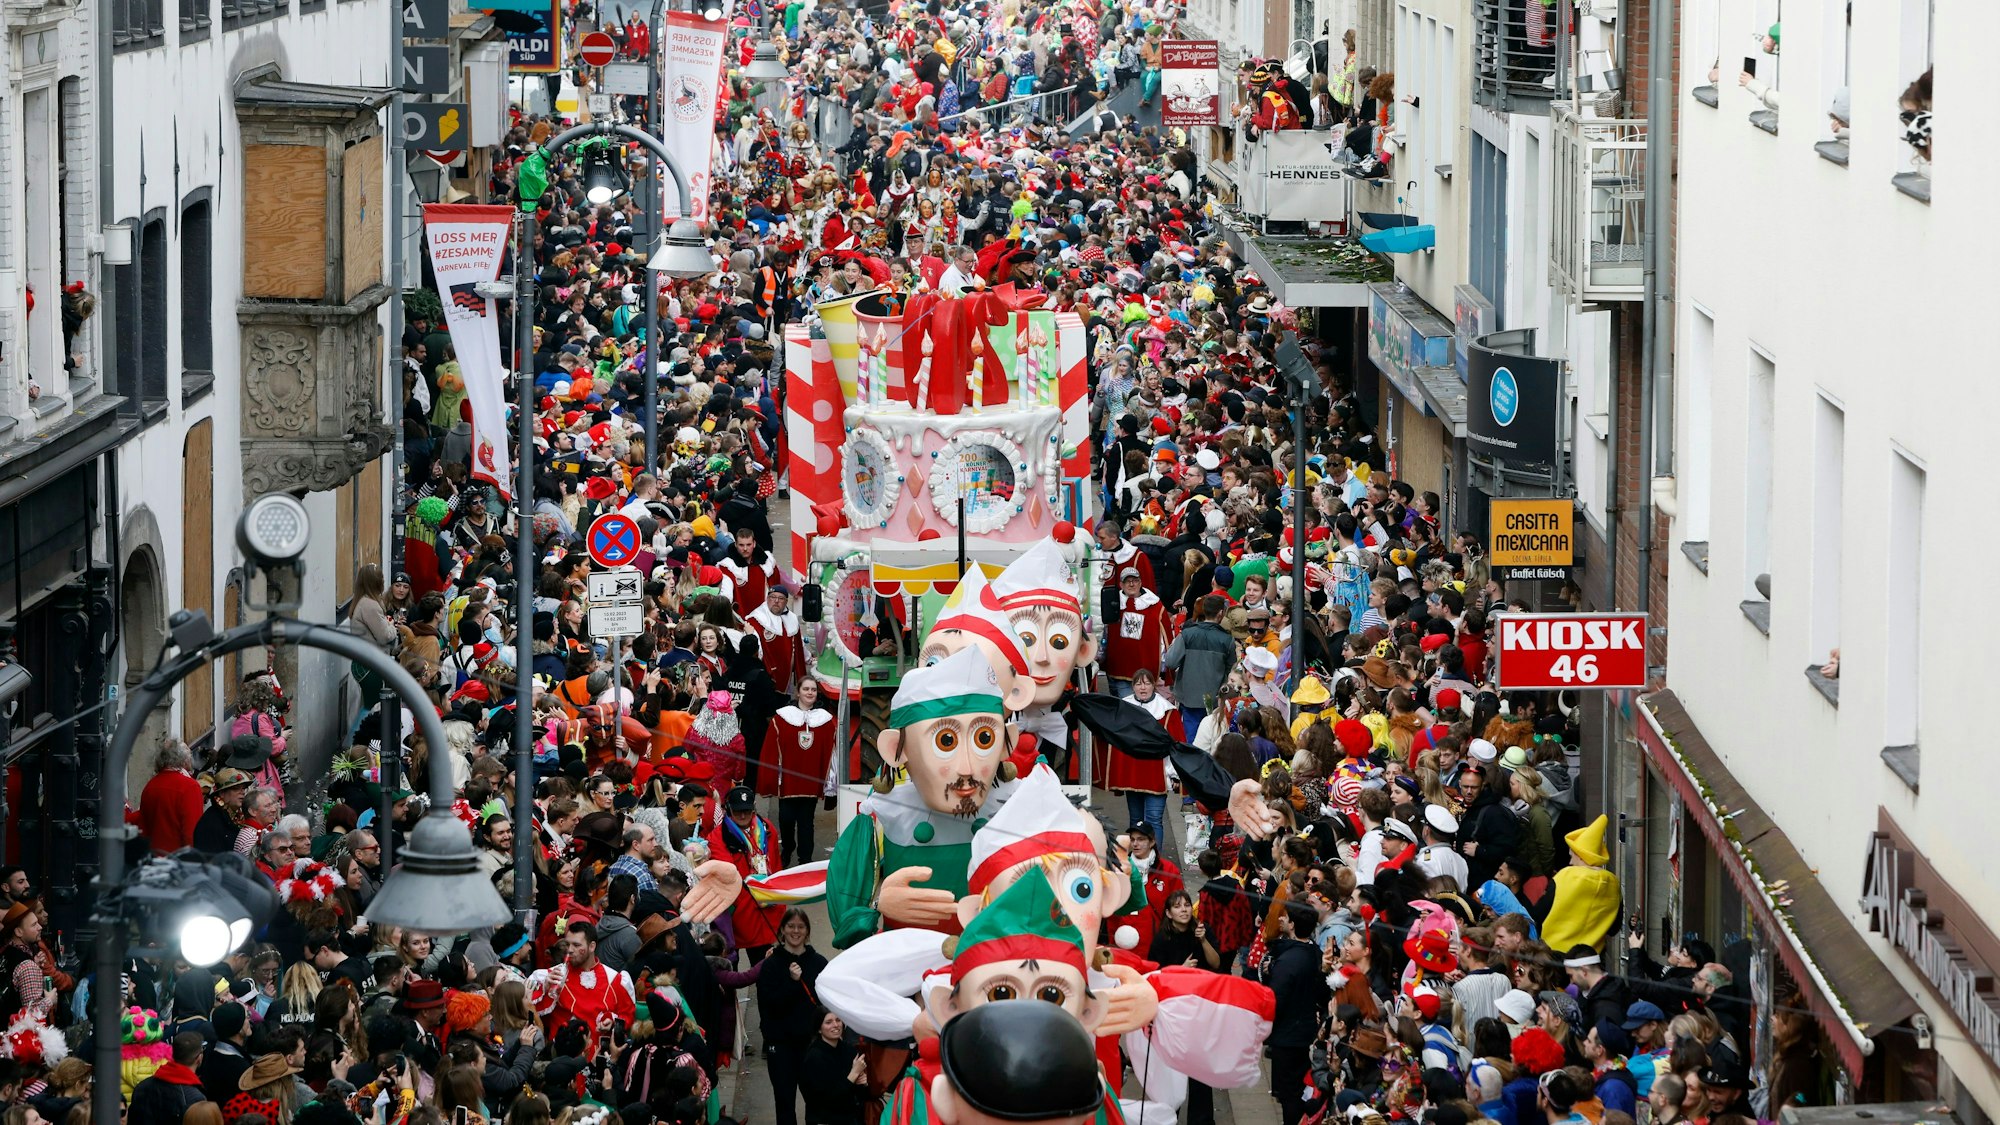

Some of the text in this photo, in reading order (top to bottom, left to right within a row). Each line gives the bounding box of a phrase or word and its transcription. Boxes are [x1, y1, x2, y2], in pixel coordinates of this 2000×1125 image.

[402, 0, 425, 29] A
[508, 38, 549, 52] ALDI
[520, 51, 536, 61] SÜD
[402, 56, 424, 85] N
[402, 111, 427, 142] O
[1270, 170, 1341, 180] HENNES
[434, 232, 498, 244] LOSS MER
[435, 247, 494, 259] #ZESAMME
[437, 263, 471, 273] KARNEVAL
[1500, 380, 1515, 397] Monat
[959, 453, 977, 462] 200
[1506, 513, 1559, 530] CASITA
[1496, 534, 1569, 551] MEXICANA
[1511, 568, 1565, 579] Gaffel Kölsch
[1502, 620, 1644, 651] KIOSK
[1549, 654, 1599, 683] 46
[728, 681, 746, 690] OLICE
